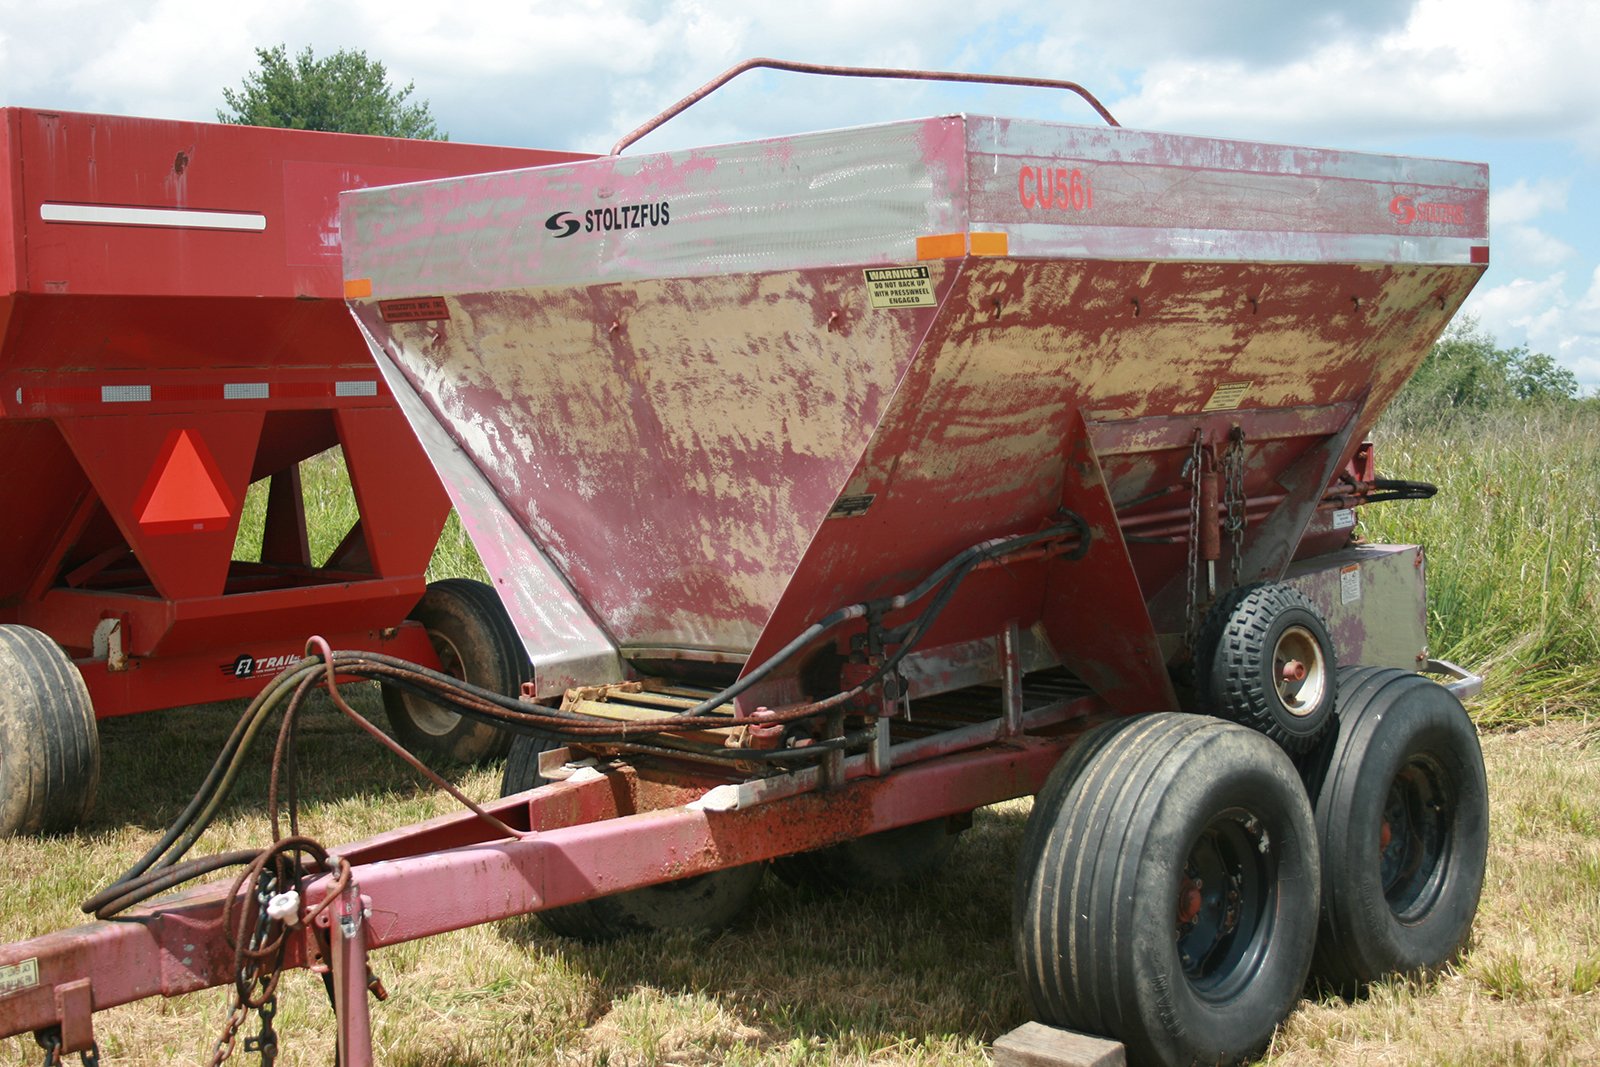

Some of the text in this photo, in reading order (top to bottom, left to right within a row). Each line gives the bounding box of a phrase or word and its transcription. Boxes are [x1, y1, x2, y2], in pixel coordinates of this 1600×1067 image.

[1018, 165, 1093, 211] CU56i
[585, 201, 669, 232] STOLTZFUS
[869, 269, 918, 280] WARNING
[890, 288, 930, 296] PRESSWHEEL
[889, 296, 920, 304] ENGAGED
